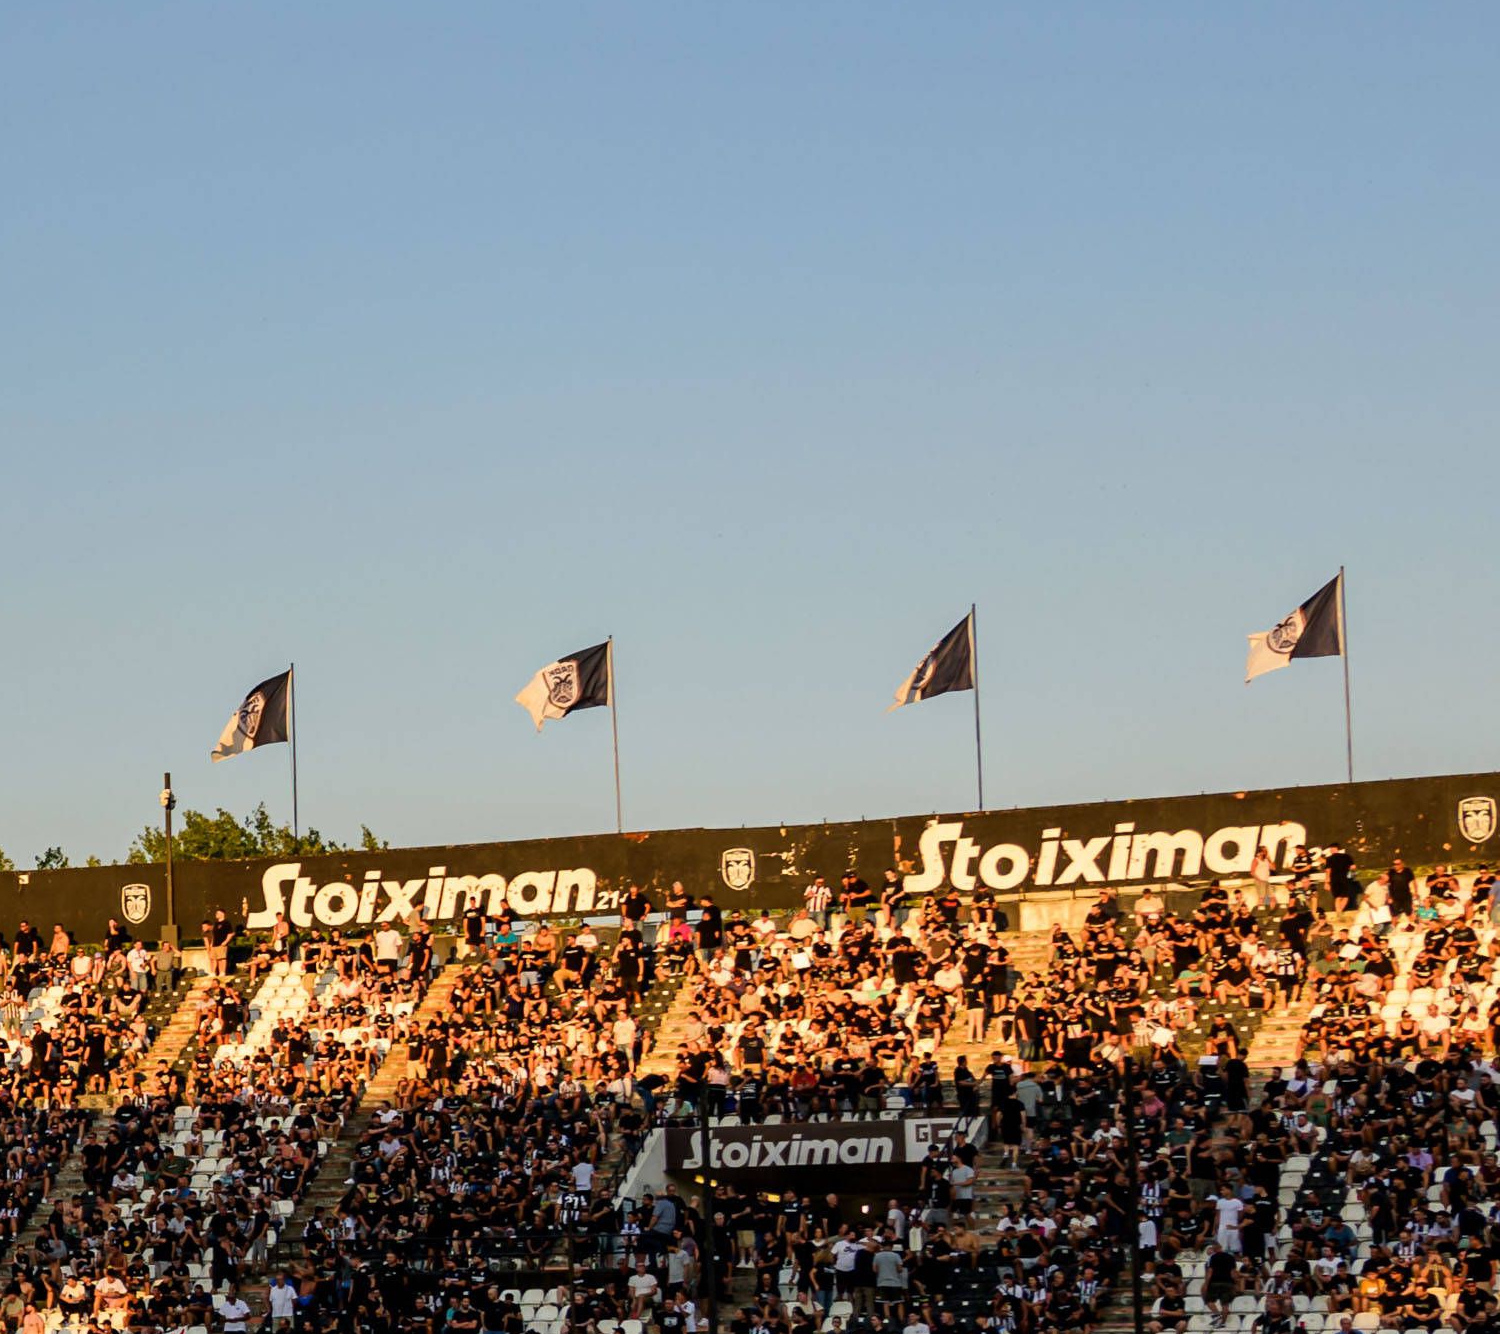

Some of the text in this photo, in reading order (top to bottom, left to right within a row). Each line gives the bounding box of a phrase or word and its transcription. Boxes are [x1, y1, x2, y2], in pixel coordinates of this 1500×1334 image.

[903, 820, 1308, 893] Stoiximan
[247, 862, 597, 928] Stoiximan
[682, 1129, 894, 1170] Stoiximan
